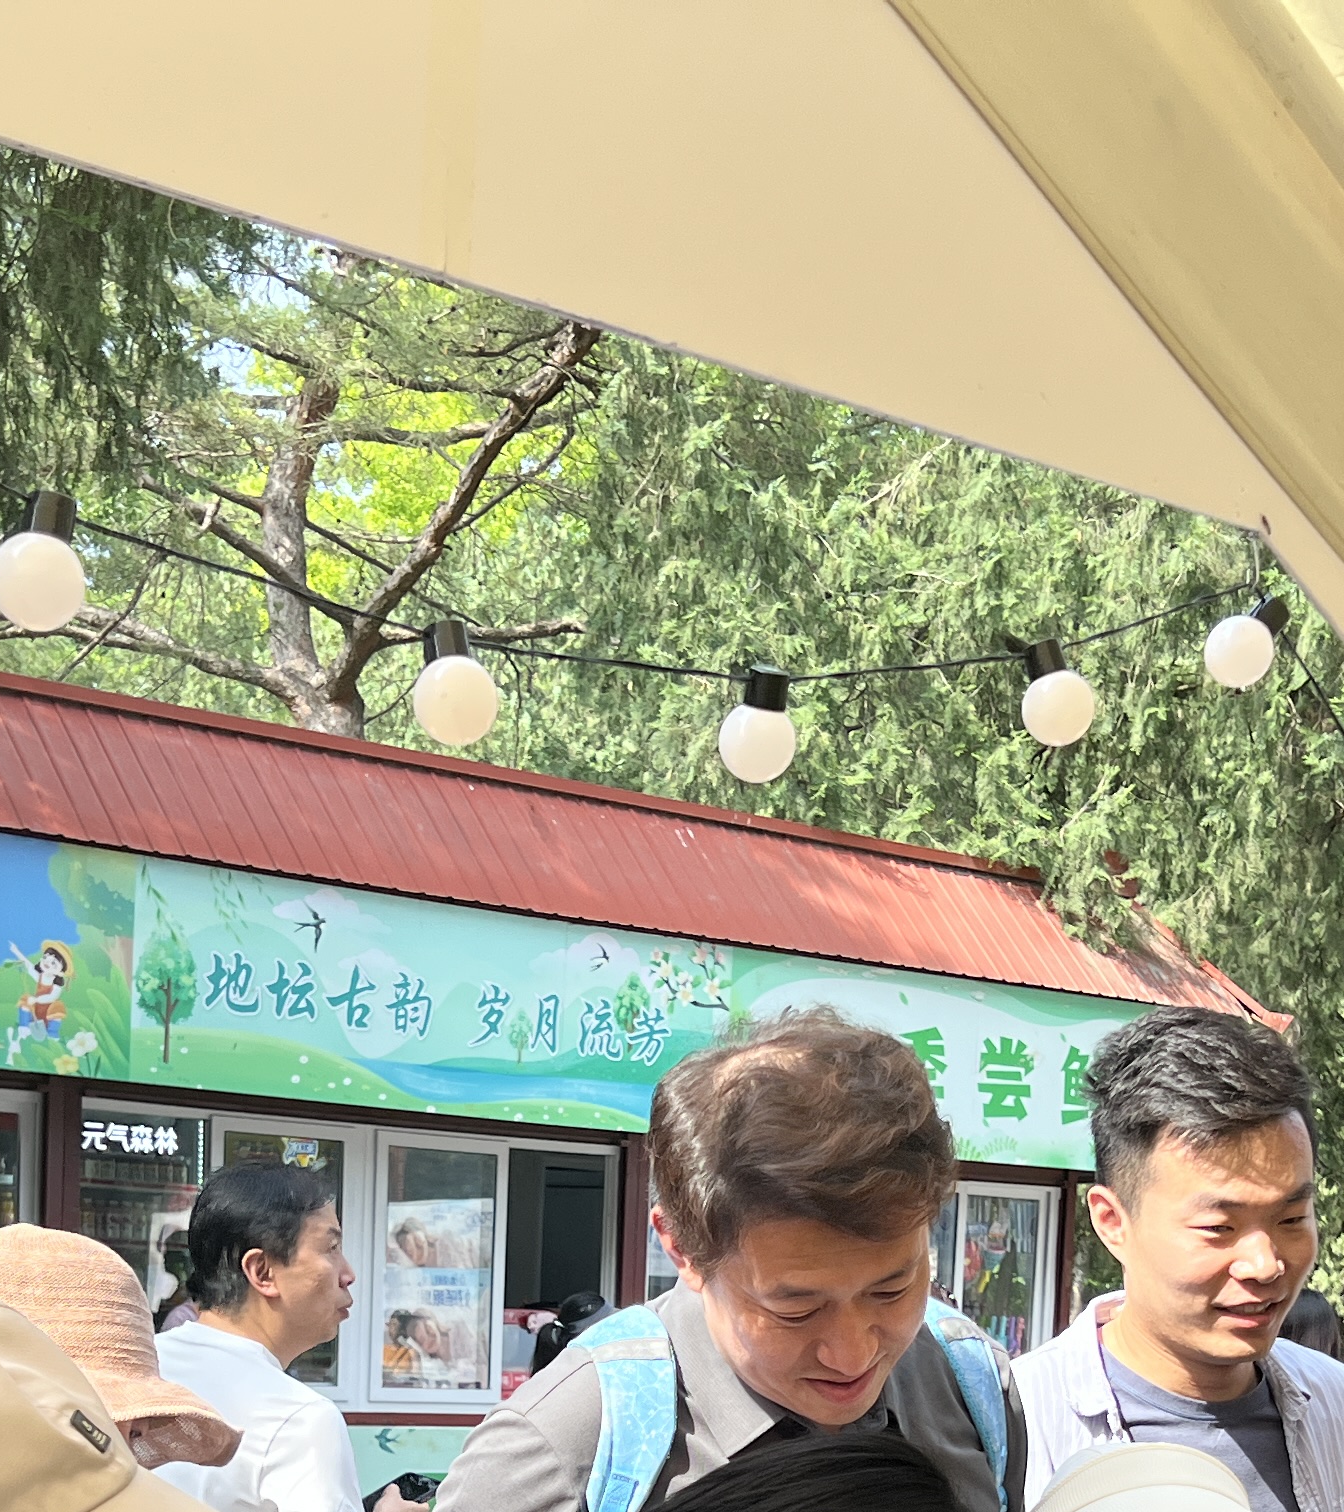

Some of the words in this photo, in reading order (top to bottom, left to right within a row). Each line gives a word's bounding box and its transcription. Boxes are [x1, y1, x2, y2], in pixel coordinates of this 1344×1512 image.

[203, 950, 435, 1037] 地坛古韵
[468, 980, 673, 1067] 岁月流芳
[81, 1120, 179, 1156] 元气森林
